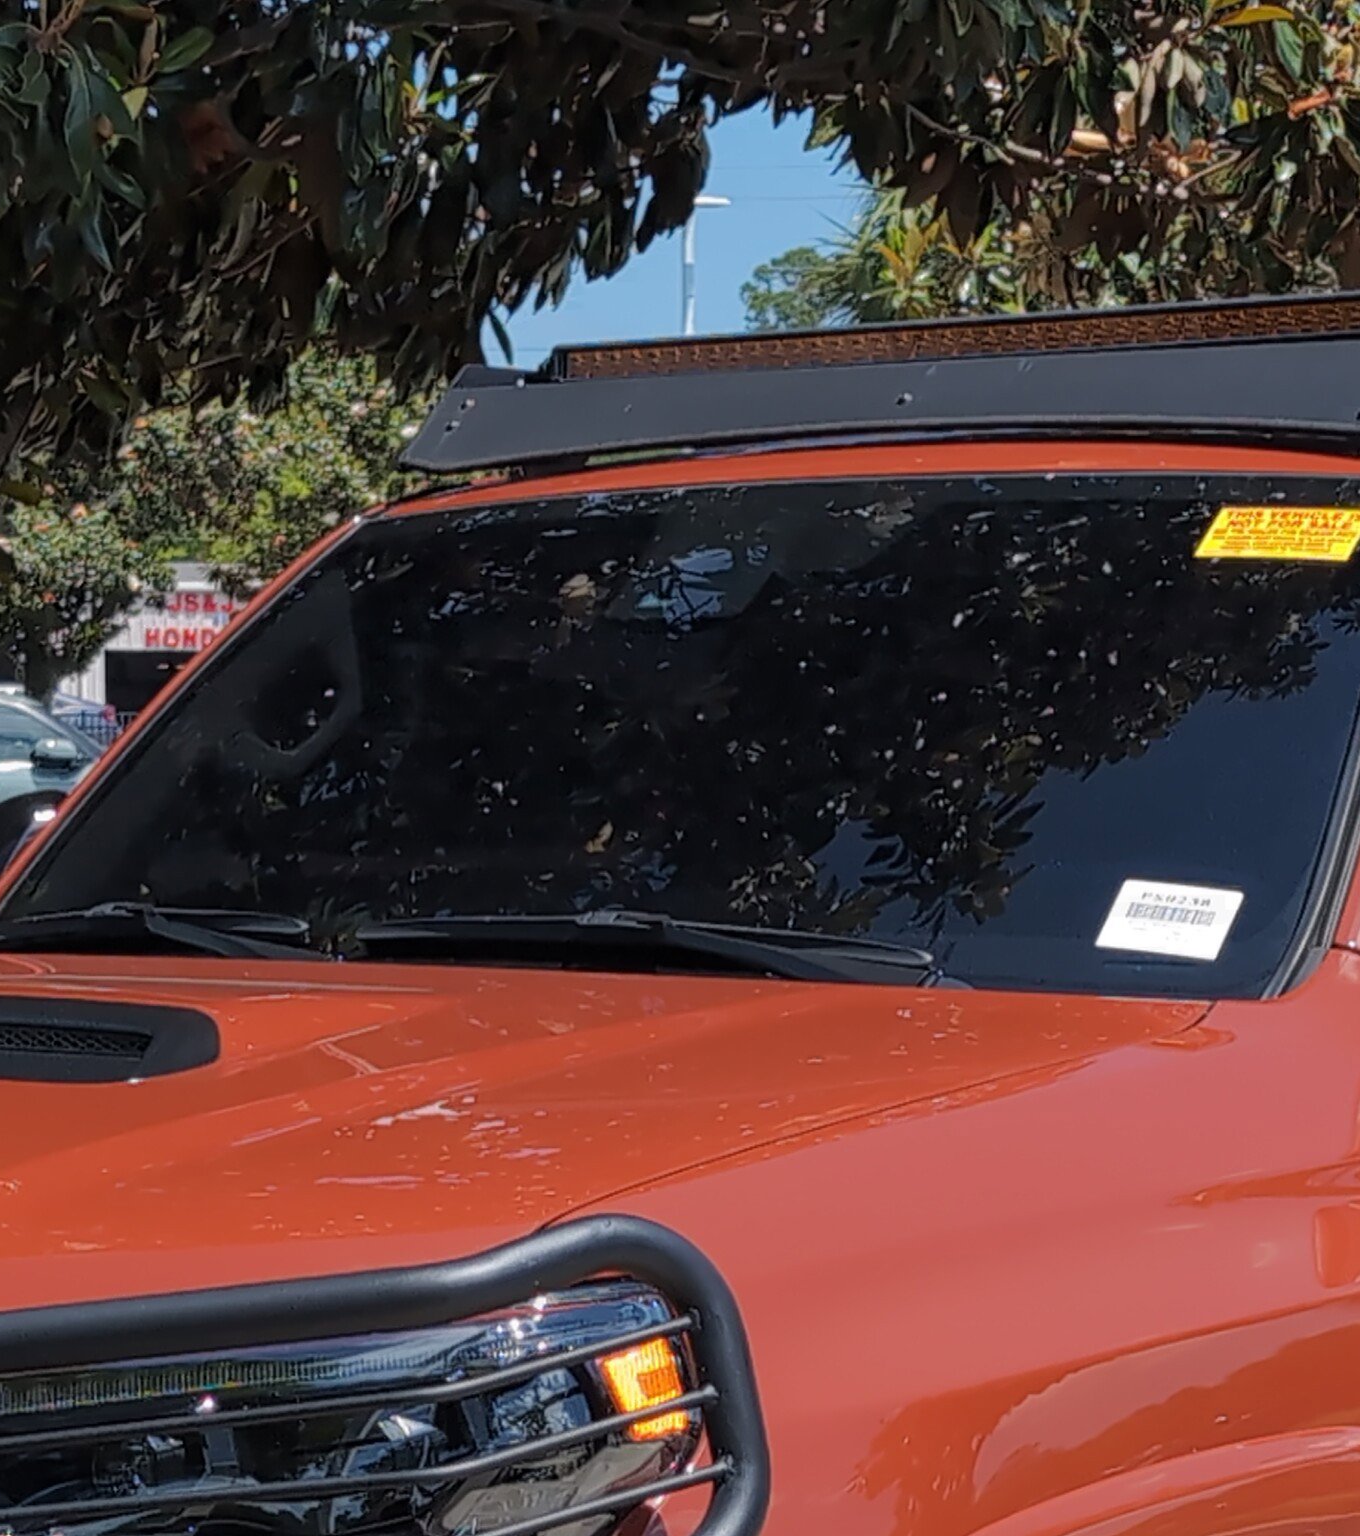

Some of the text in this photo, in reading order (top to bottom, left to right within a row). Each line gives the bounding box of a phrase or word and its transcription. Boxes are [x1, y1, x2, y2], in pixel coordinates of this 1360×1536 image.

[1270, 511, 1343, 521] VEHICLE
[1309, 520, 1353, 530] SALE
[145, 628, 217, 648] HOND
